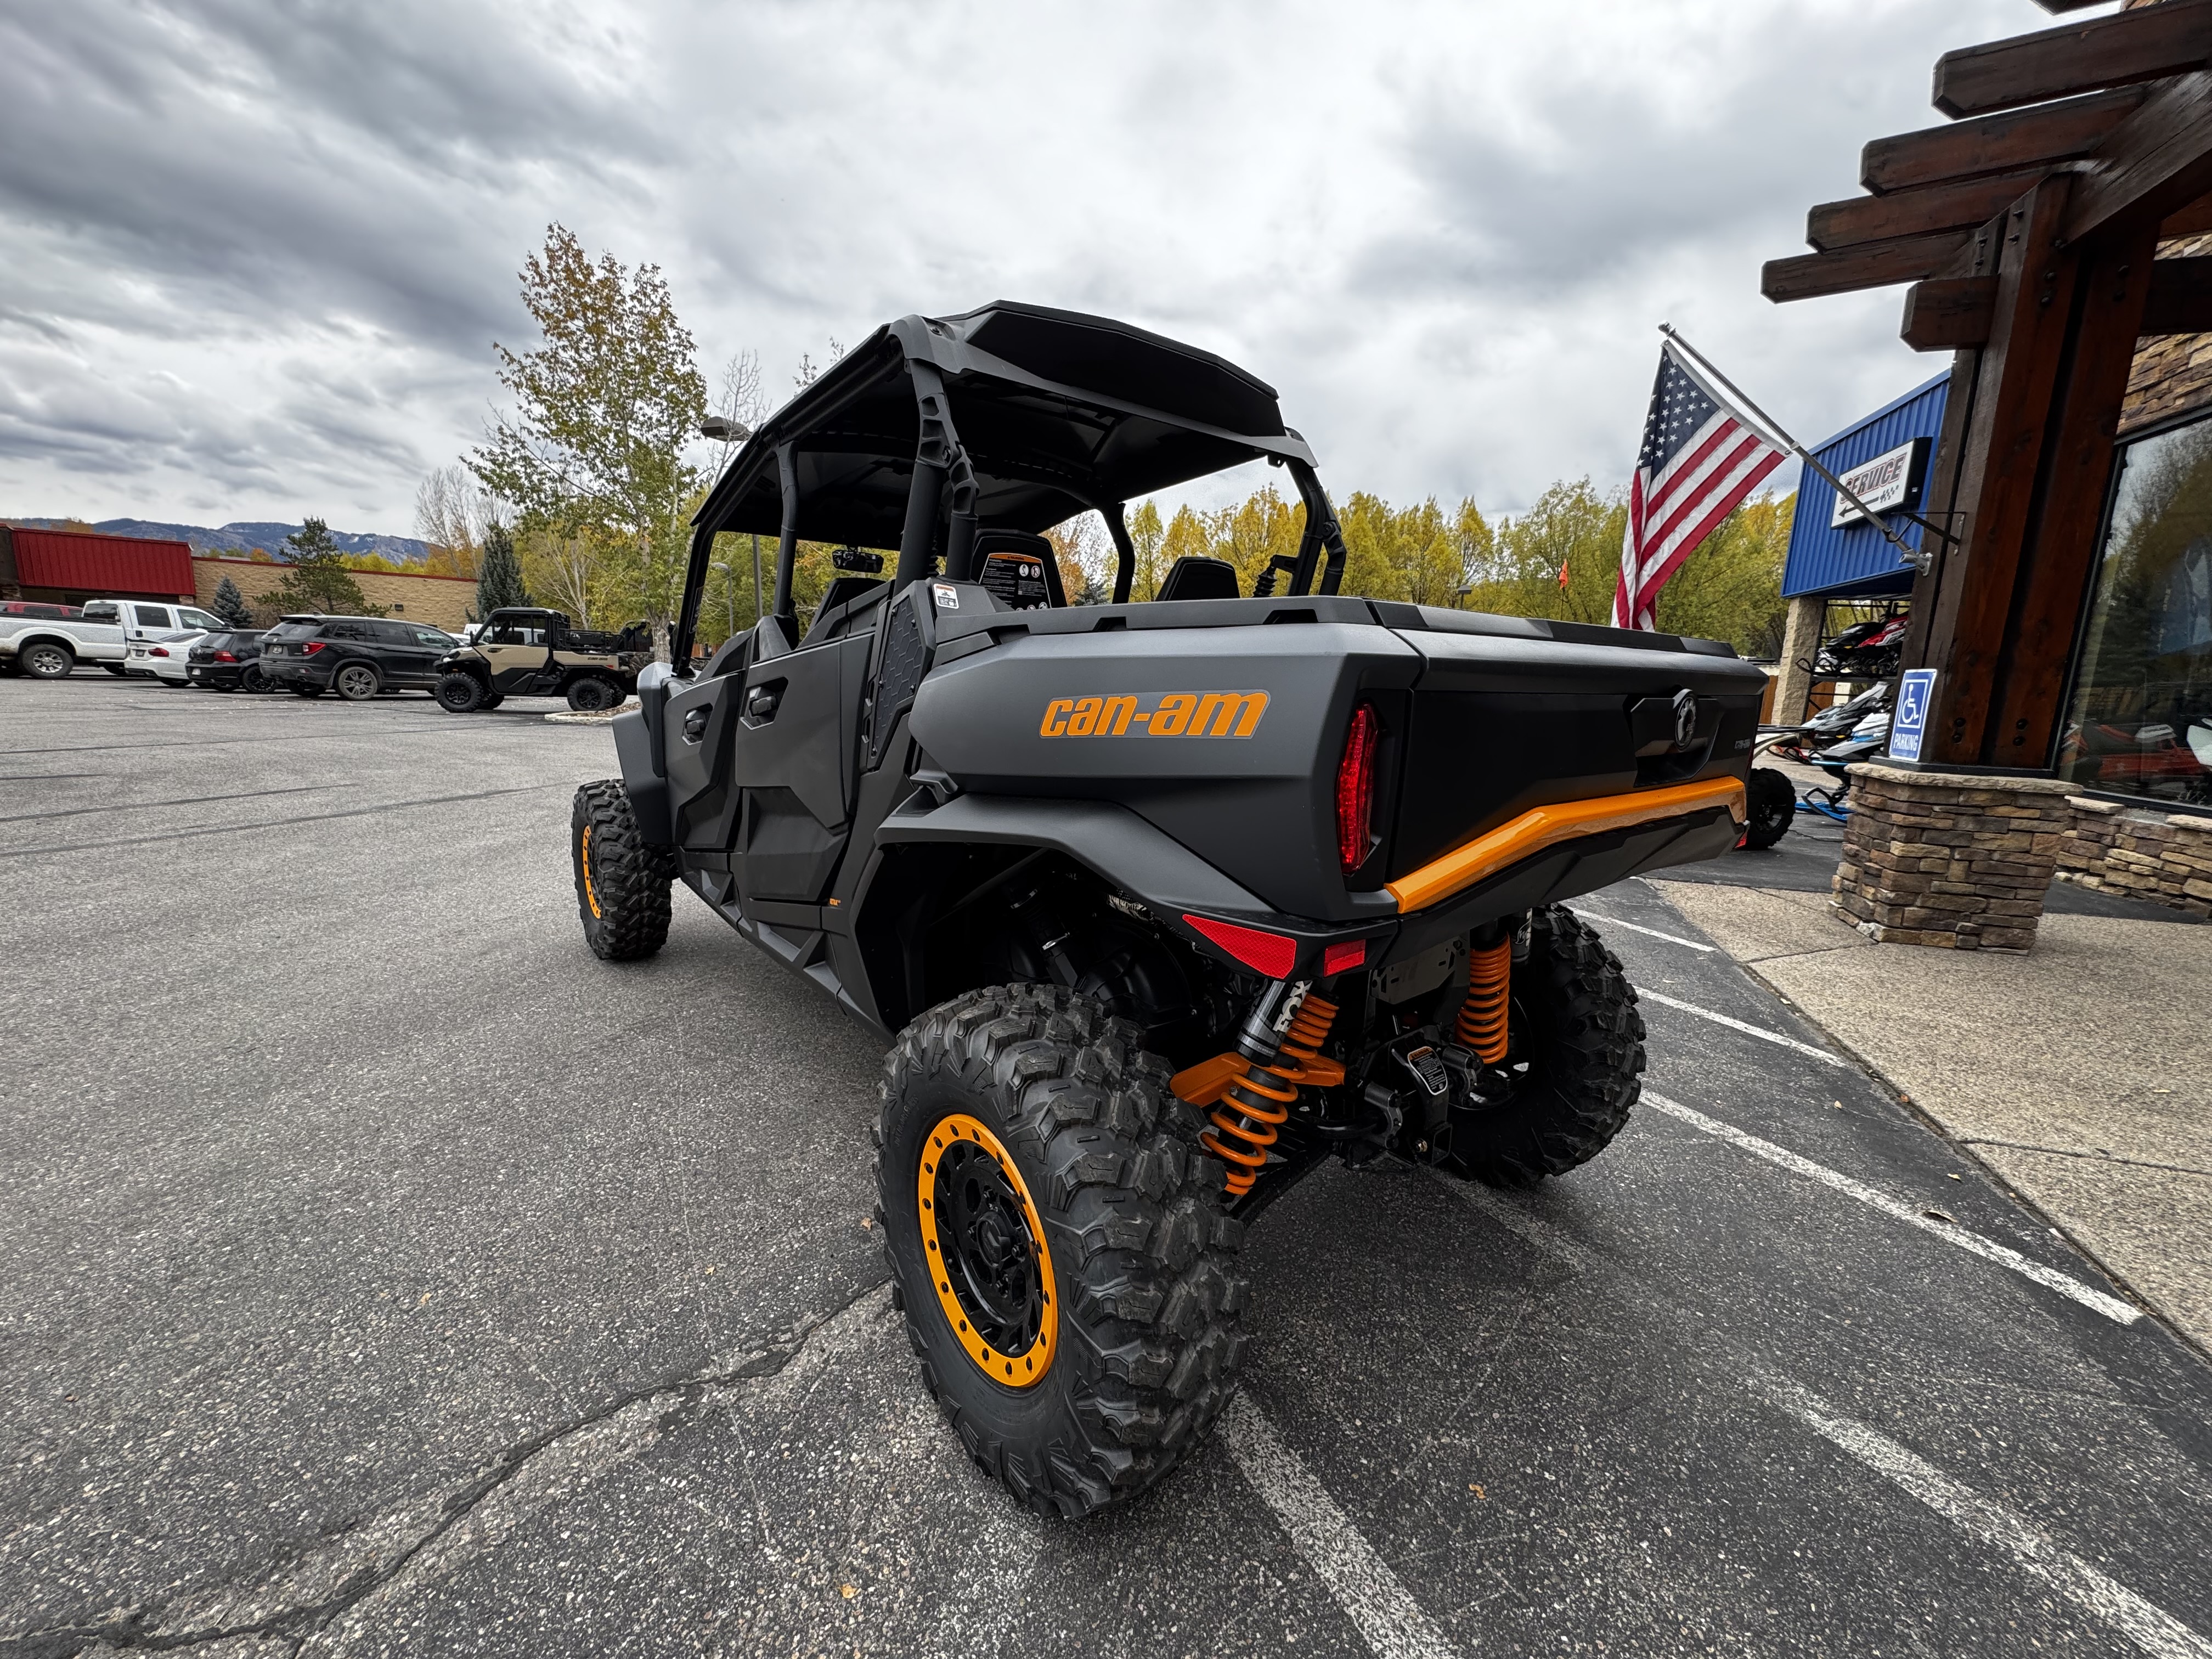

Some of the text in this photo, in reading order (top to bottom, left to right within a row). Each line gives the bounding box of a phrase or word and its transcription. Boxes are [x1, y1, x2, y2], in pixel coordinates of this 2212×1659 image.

[1040, 693, 1268, 737] can-am
[1893, 733, 1918, 752] PARKING
[1272, 980, 1313, 1034] FOX
